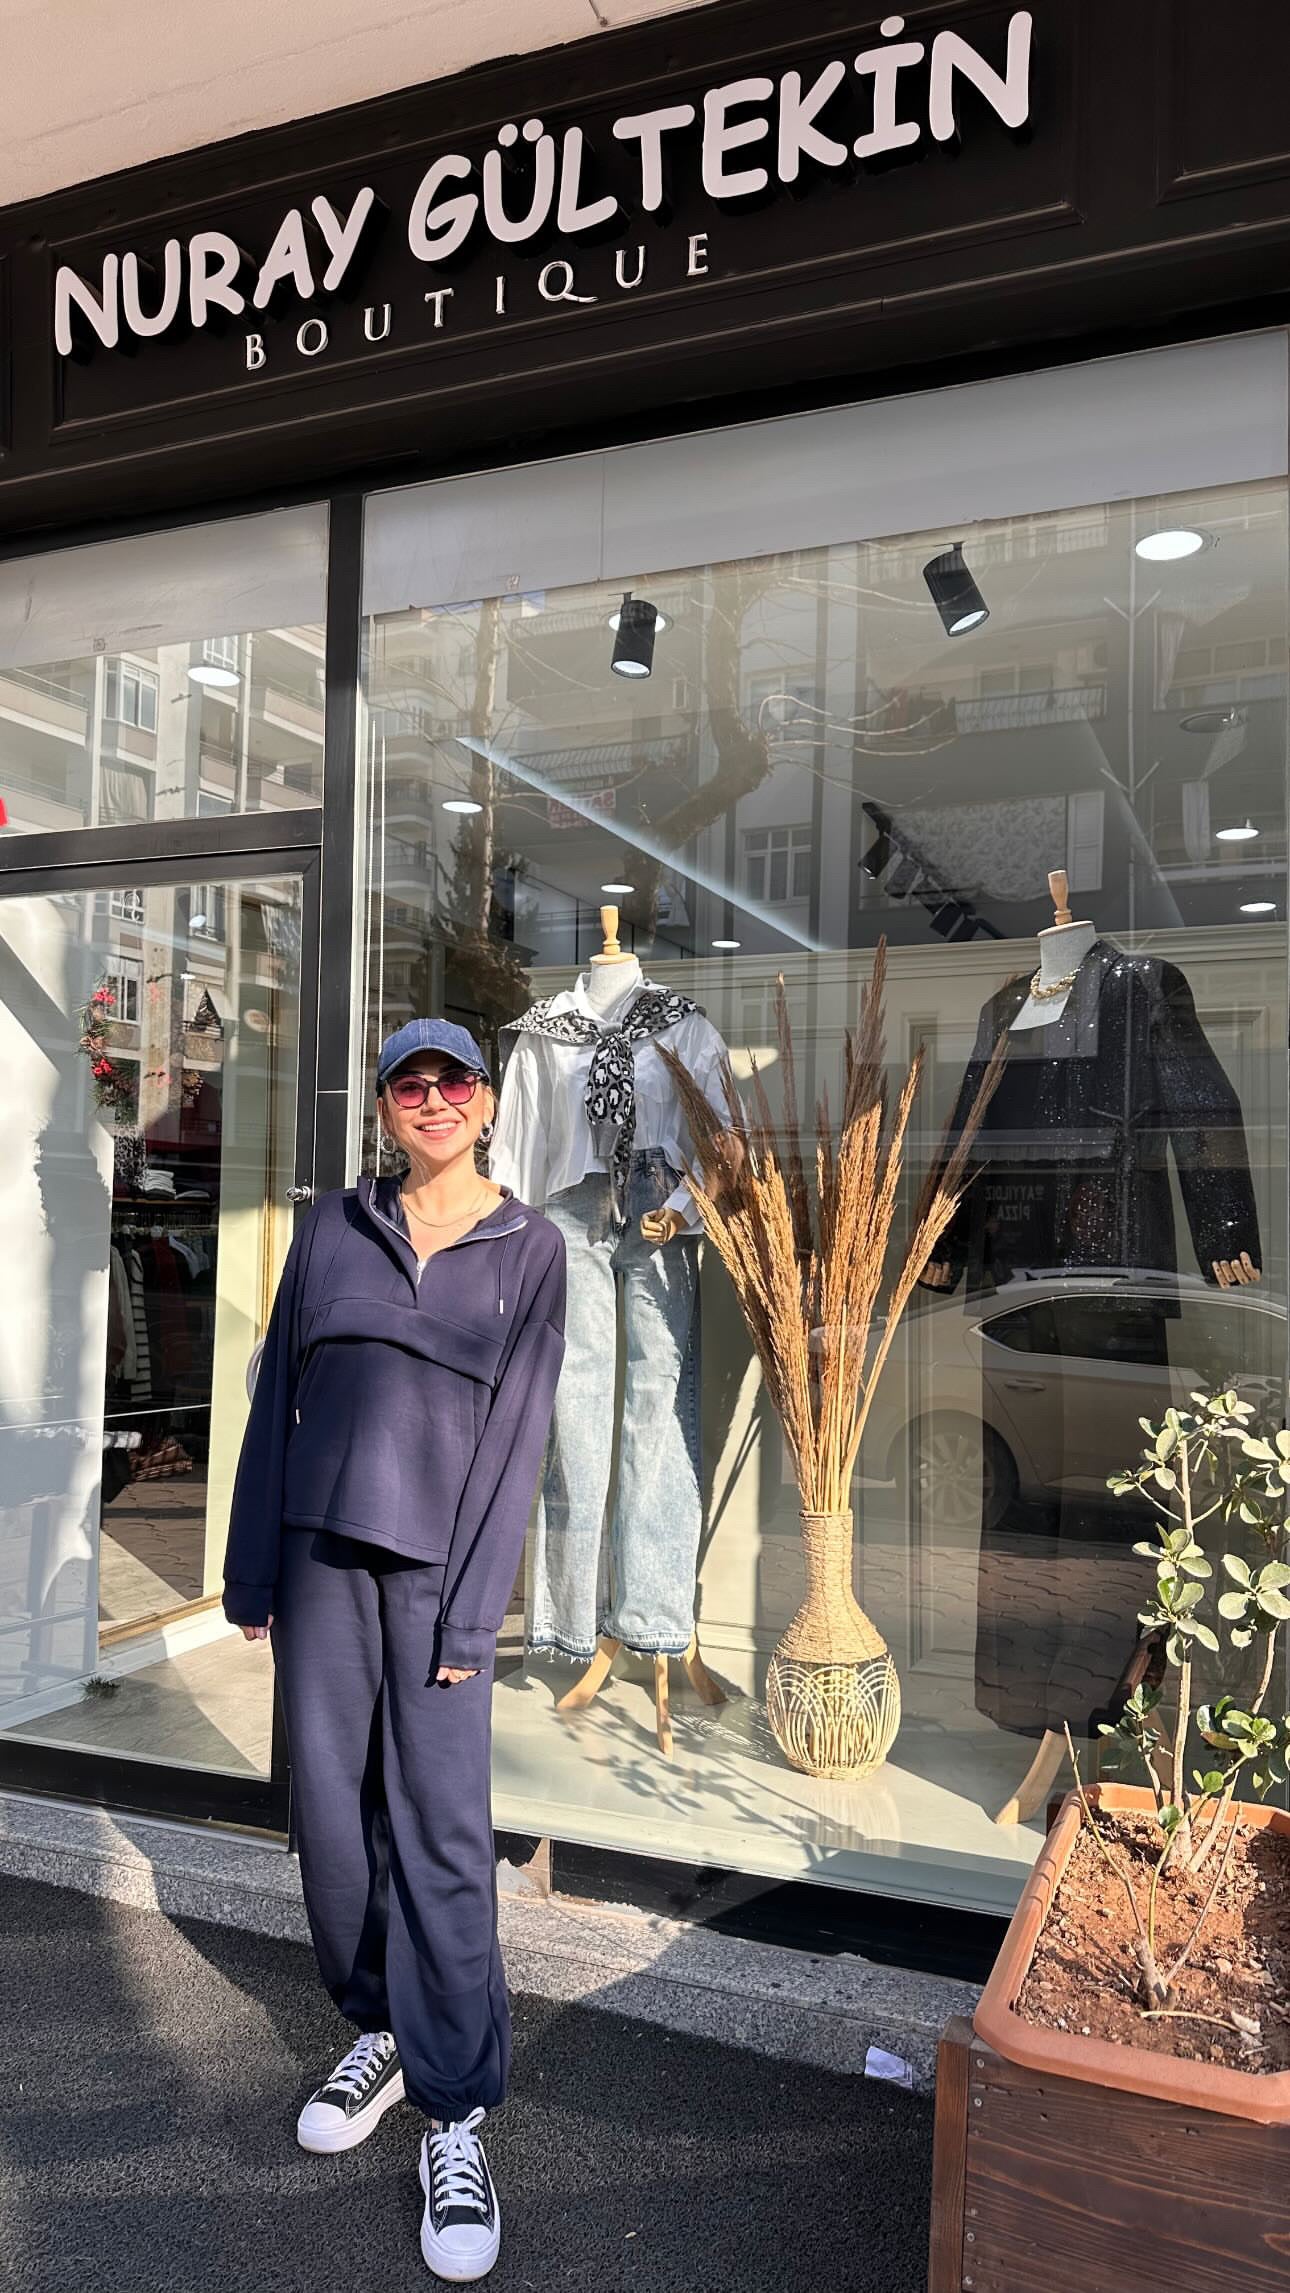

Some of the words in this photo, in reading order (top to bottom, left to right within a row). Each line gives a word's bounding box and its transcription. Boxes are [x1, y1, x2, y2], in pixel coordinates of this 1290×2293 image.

[54, 187, 375, 357] NURAY
[408, 11, 1033, 263] GÜLTEKİN
[245, 233, 709, 372] BOUTIQUE
